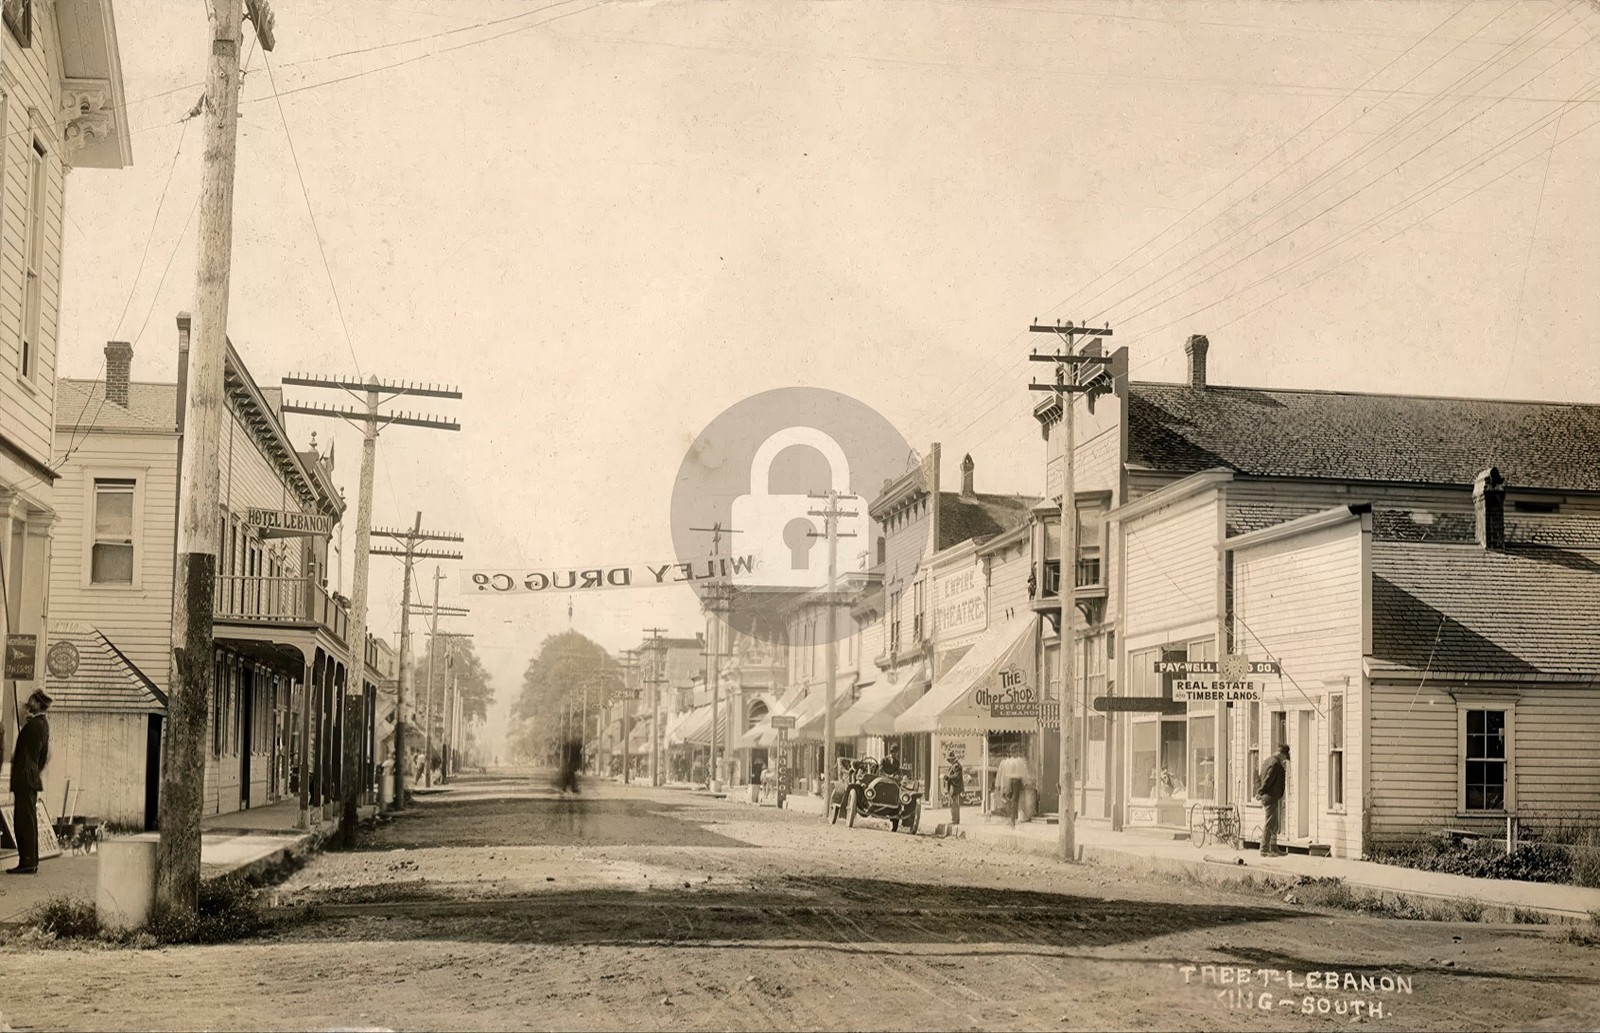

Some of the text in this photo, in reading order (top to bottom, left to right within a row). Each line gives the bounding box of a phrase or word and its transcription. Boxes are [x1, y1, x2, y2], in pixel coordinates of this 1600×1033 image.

[249, 509, 329, 533] HOTEL LEBANON
[1160, 662, 1214, 673] PAY-WELL
[1257, 663, 1275, 673] CO.
[999, 671, 1021, 688] THE
[1177, 681, 1254, 690] REAL ESTATE
[976, 687, 1034, 705] Other Shop.
[1186, 691, 1224, 700] TIMBER
[1227, 691, 1261, 700] LANDS.
